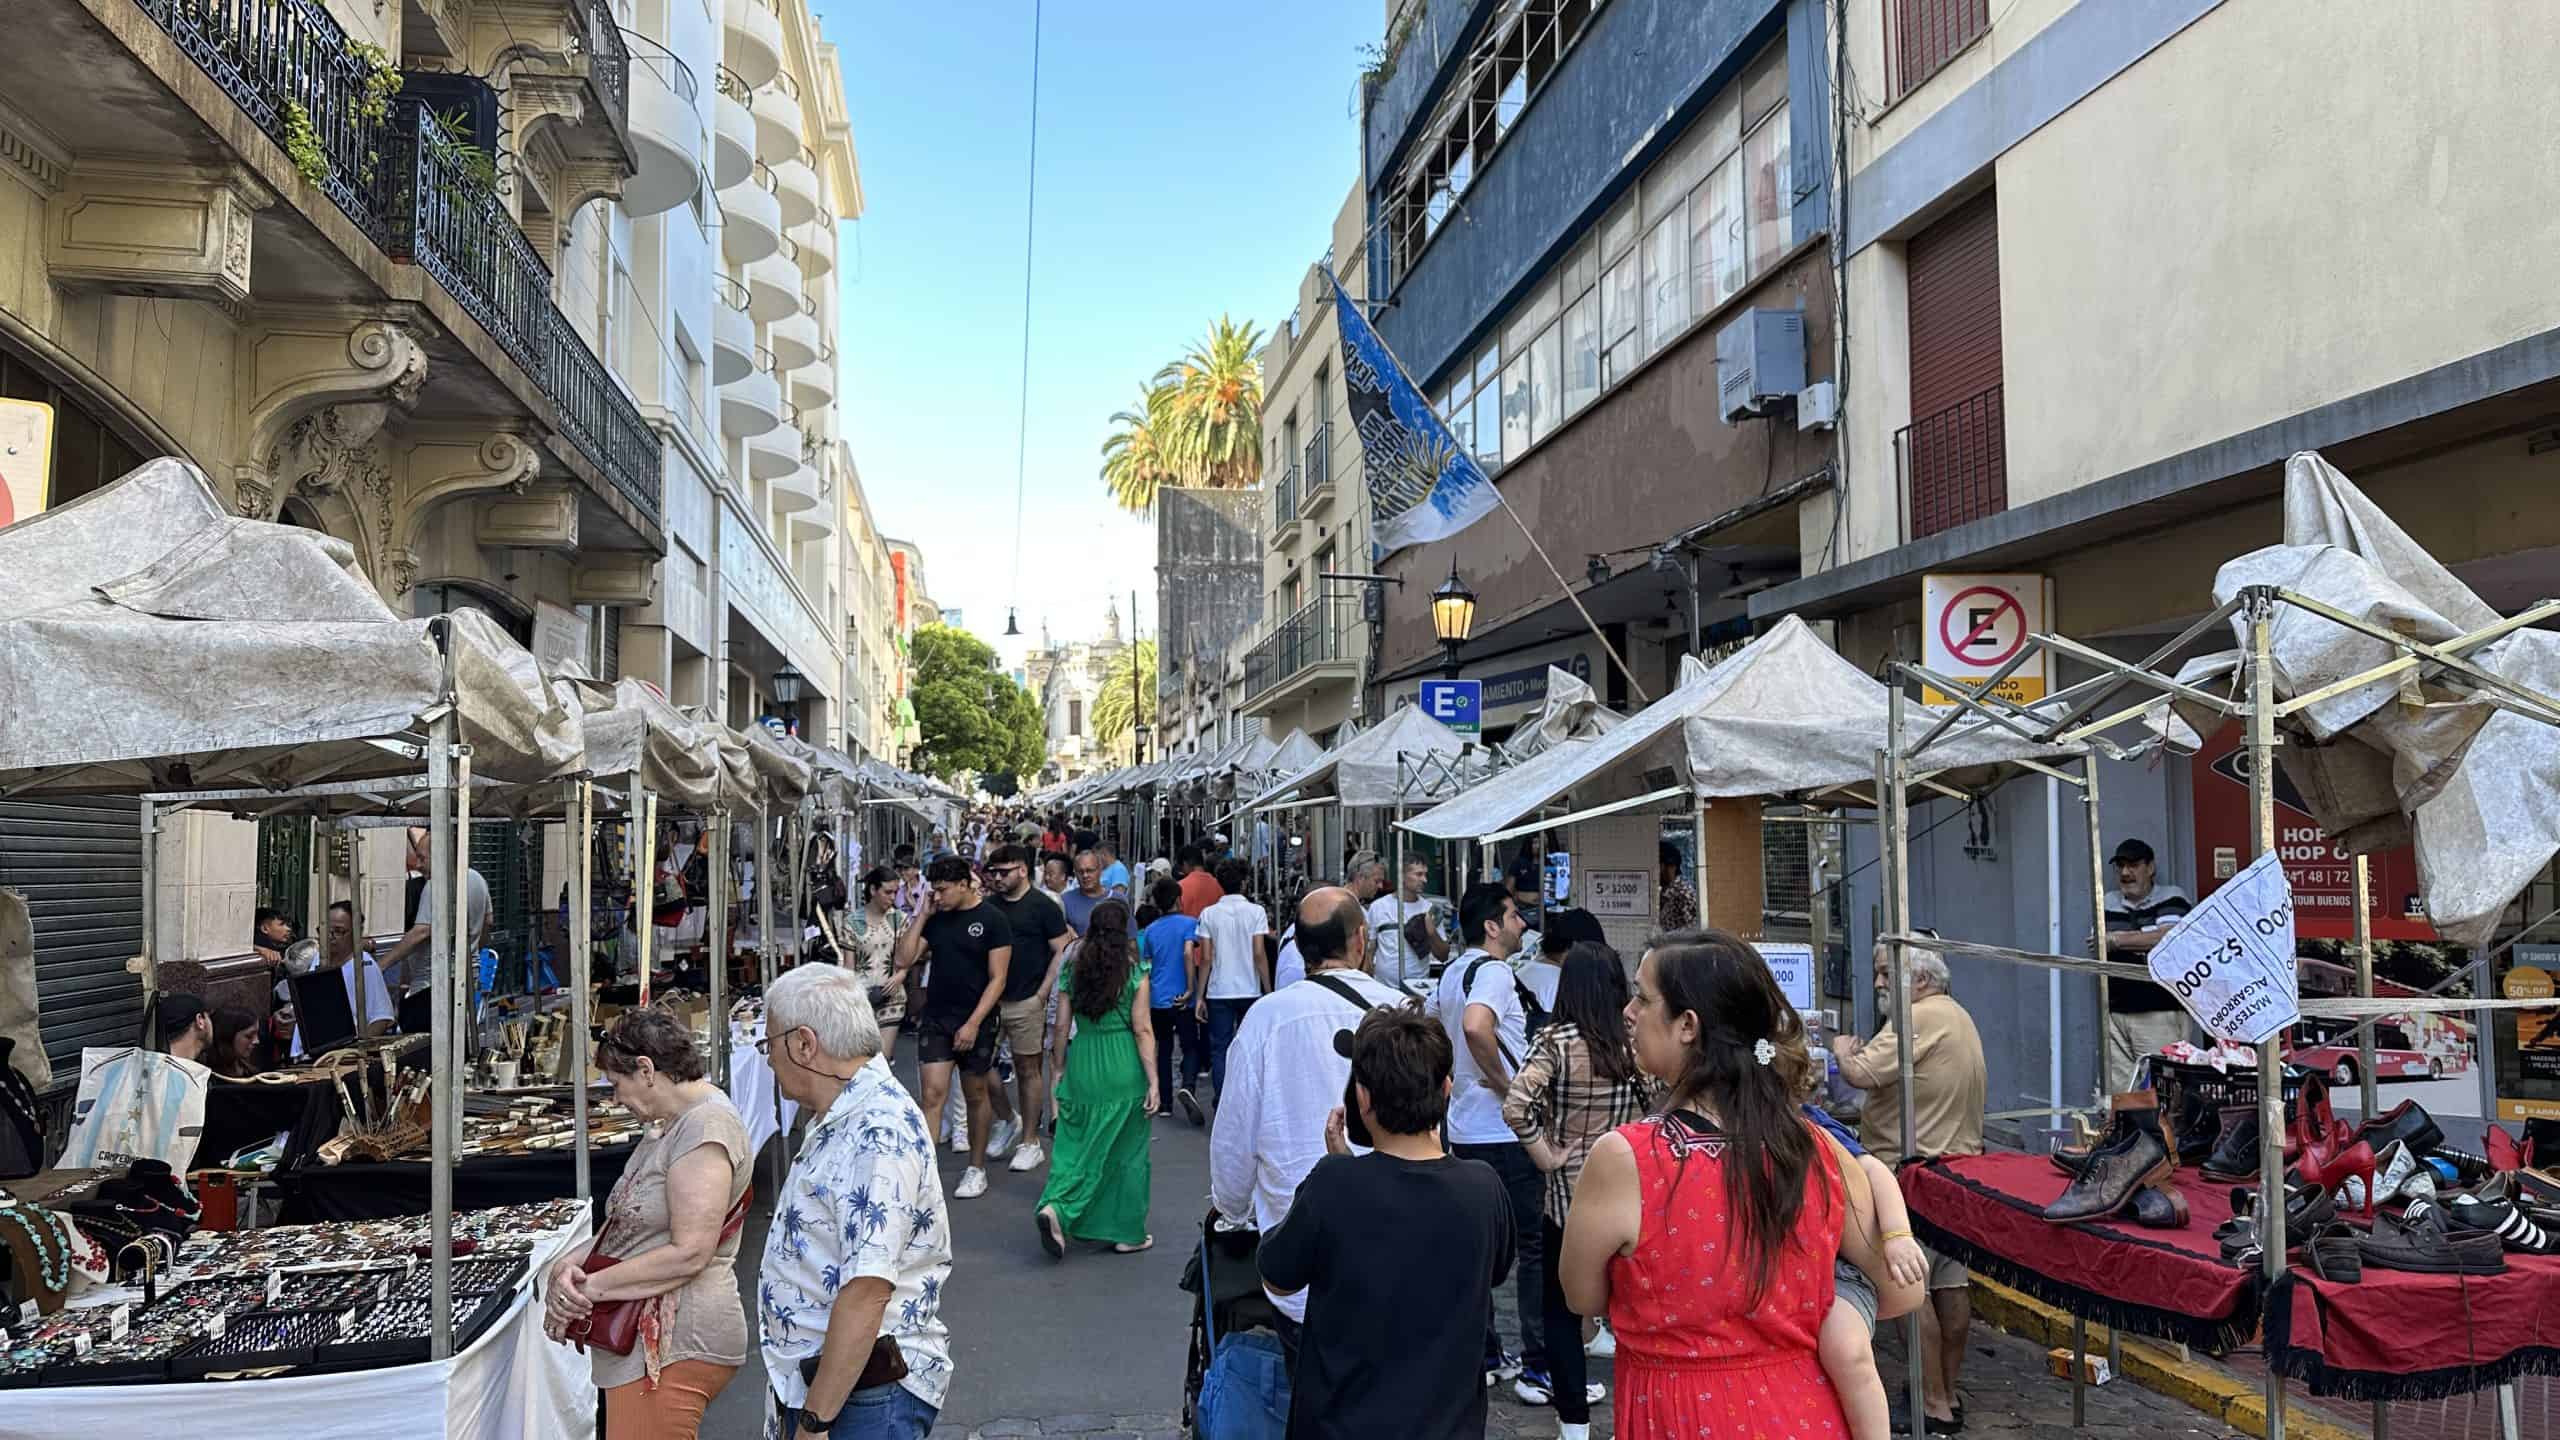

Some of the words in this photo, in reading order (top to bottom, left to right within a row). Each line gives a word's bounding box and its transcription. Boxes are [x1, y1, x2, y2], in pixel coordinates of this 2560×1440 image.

[1969, 608, 1998, 645] E
[1434, 687, 1456, 716] E
[2280, 846, 2326, 860] HOP
[2308, 870, 2323, 882] 48
[2335, 871, 2350, 882] 72
[2317, 896, 2351, 906] BUENOS
[2175, 936, 2244, 997] $2.000
[2210, 976, 2269, 1027] ALGARROBO
[2235, 994, 2273, 1025] MATES
[2224, 1020, 2239, 1036] DE
